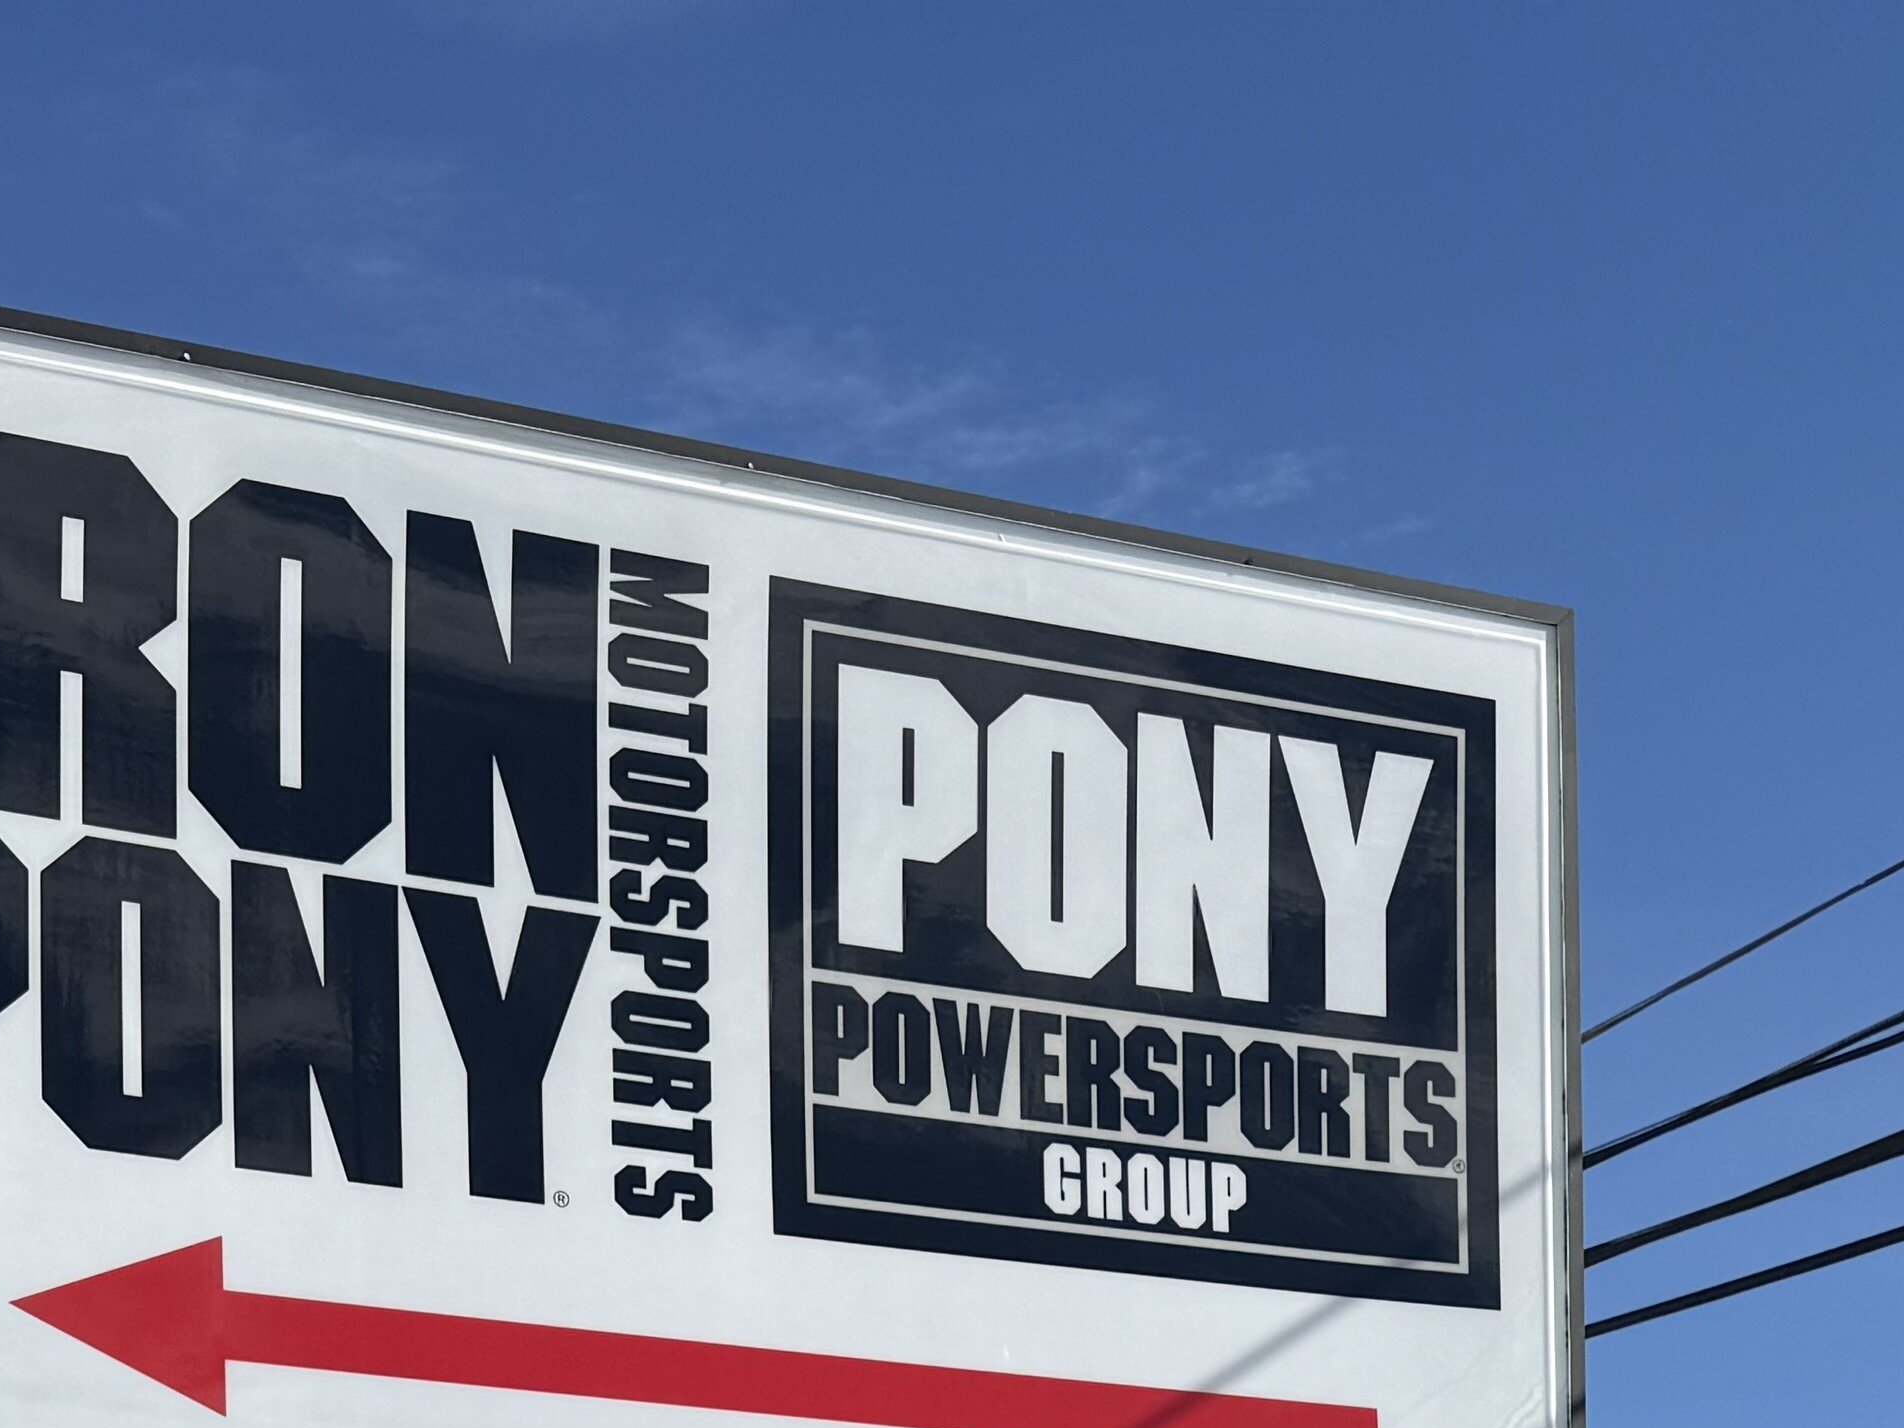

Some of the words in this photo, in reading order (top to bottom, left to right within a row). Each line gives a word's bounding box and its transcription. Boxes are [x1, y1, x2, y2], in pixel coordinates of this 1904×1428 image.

[607, 547, 716, 1226] MOTORSPORTS
[835, 662, 1438, 1018] PONY
[811, 979, 1459, 1170] POWERSPORTS
[1041, 1142, 1249, 1236] GROUP
